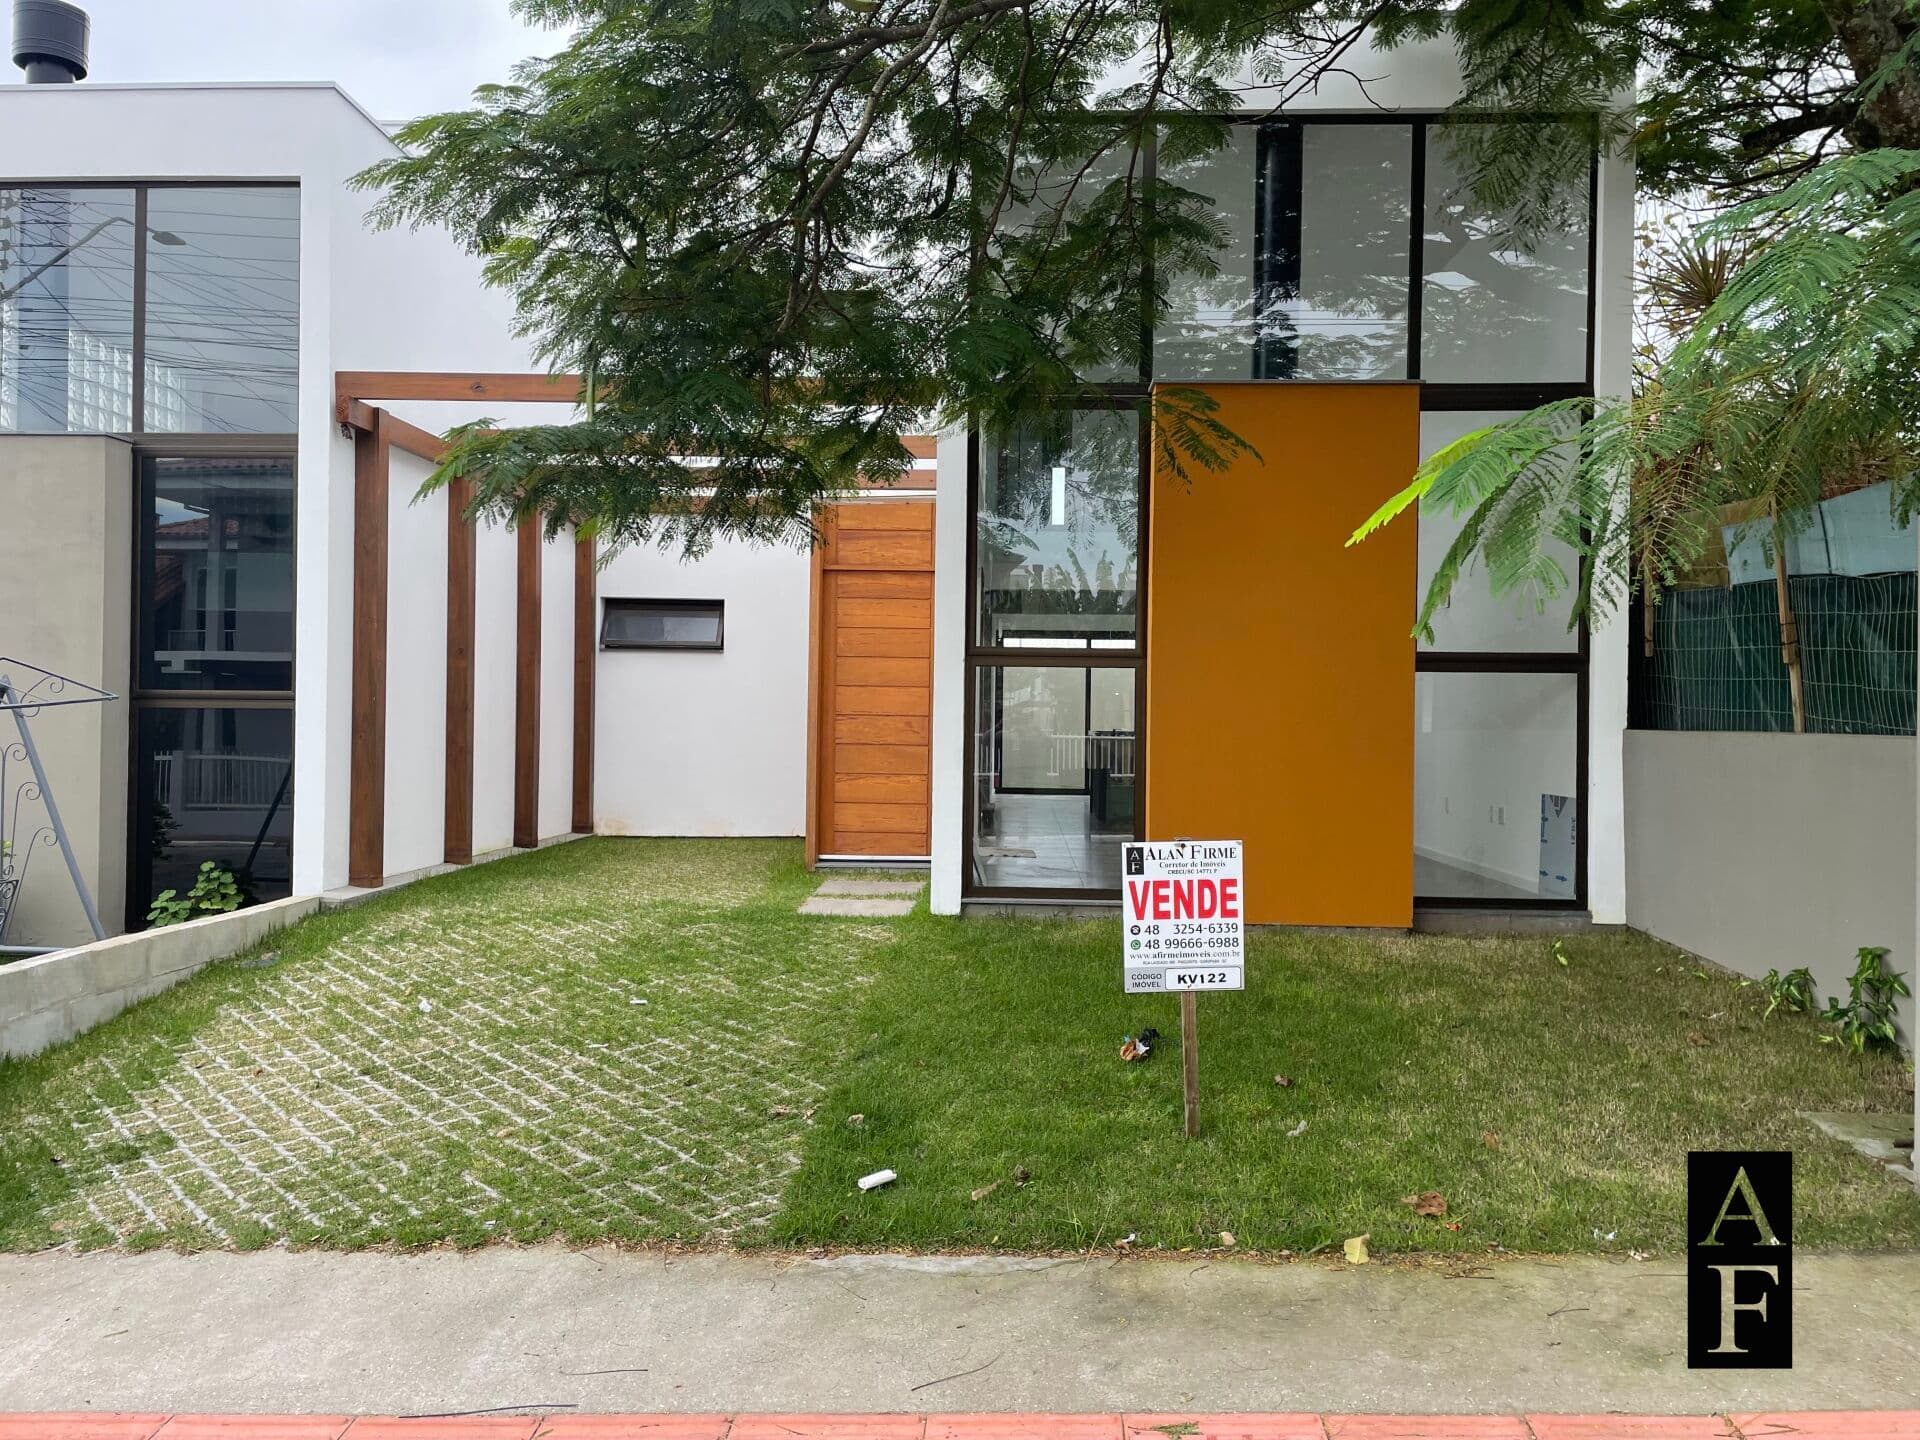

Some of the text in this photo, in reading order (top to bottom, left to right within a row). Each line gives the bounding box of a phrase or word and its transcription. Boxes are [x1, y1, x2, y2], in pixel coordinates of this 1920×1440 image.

[1130, 850, 1140, 860] A
[1145, 845, 1237, 860] ALAN FIRME
[1131, 862, 1141, 873] F
[1200, 860, 1226, 868] Imóveis
[1128, 878, 1239, 920] VENDE
[1144, 922, 1238, 935] 48 3254-6339
[1144, 937, 1239, 950] 48 99666-6988
[1130, 950, 1240, 959] www.afirmeimoveis.com.br
[1177, 972, 1226, 984] KV122
